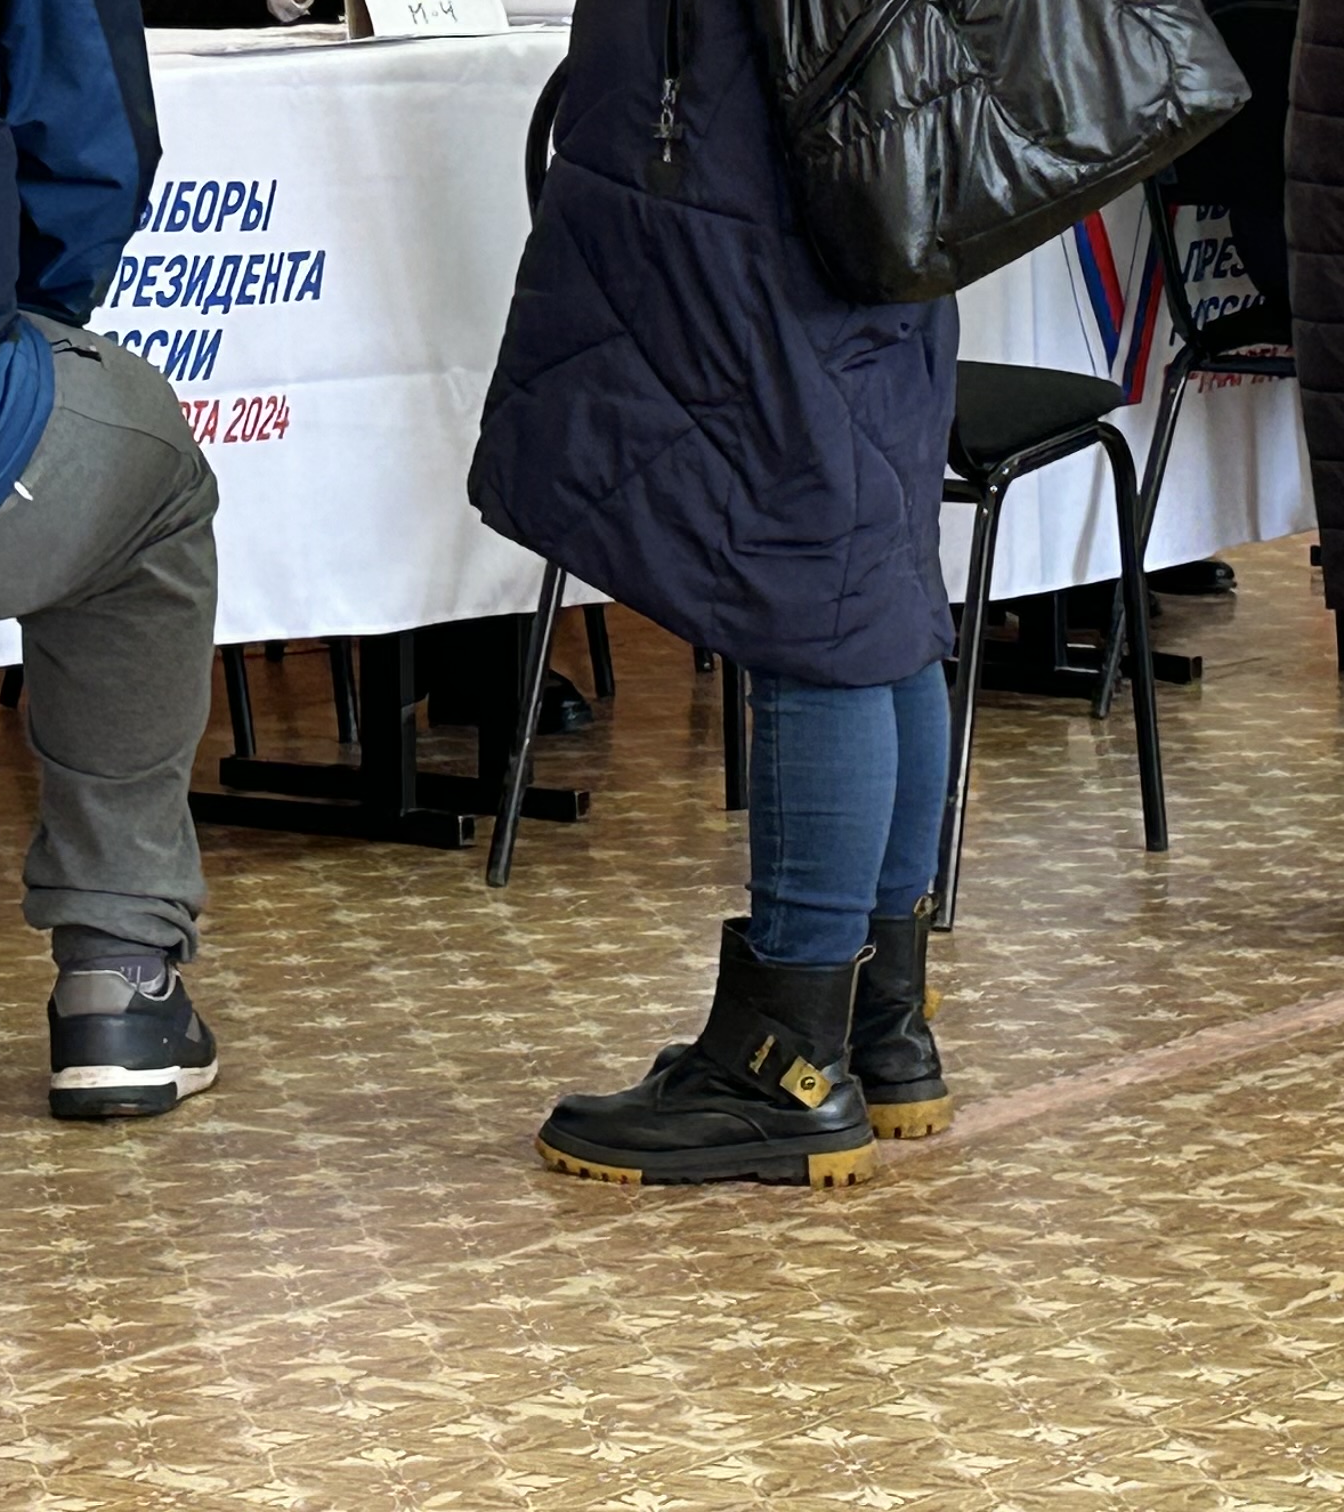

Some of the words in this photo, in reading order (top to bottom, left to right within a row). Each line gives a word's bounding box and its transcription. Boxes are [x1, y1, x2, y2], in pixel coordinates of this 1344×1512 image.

[137, 179, 277, 233] ЫБОРЫ
[110, 250, 326, 315] РЕЗИДЕНТА
[223, 394, 290, 444] 2024
